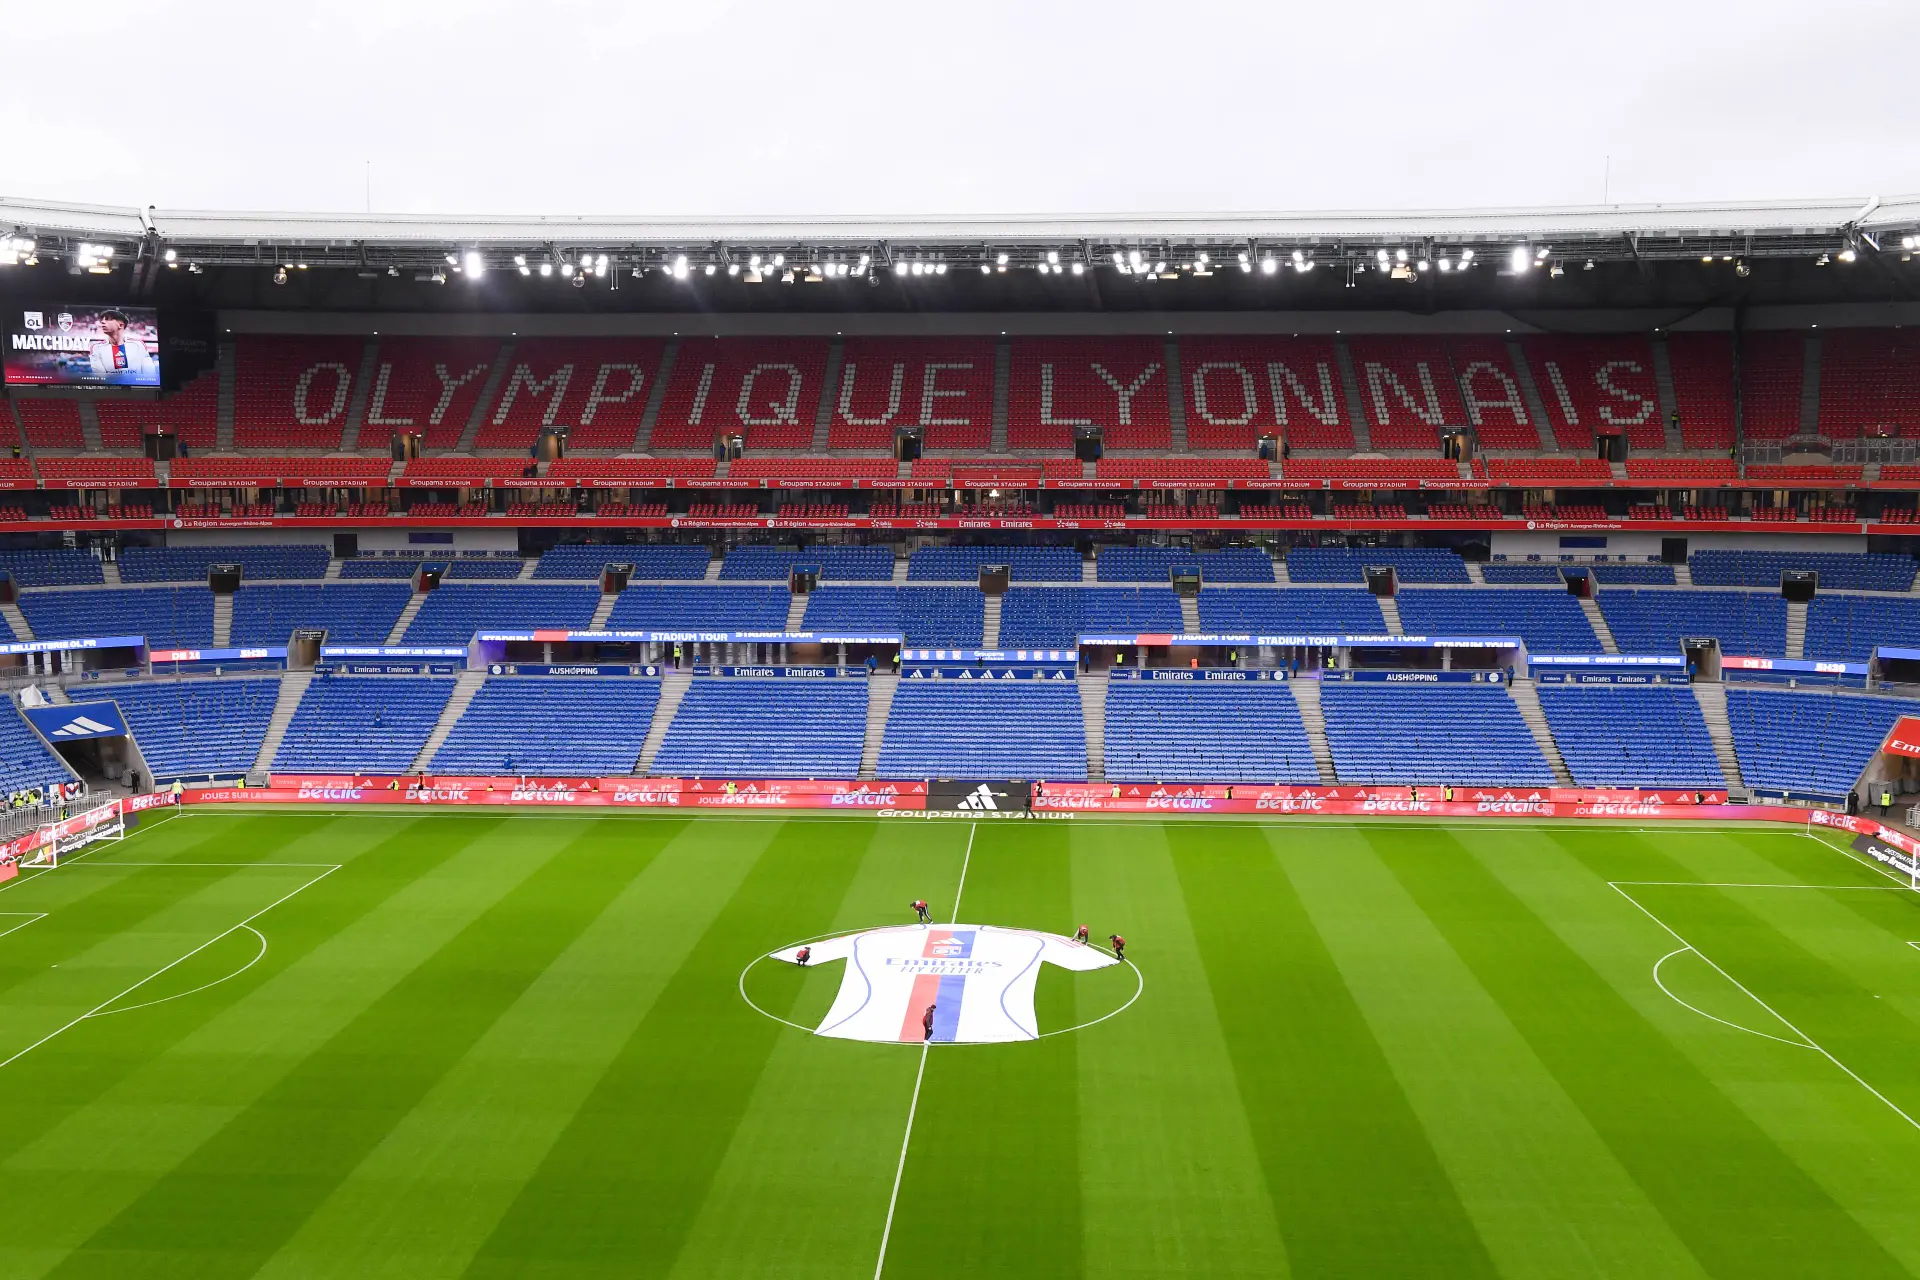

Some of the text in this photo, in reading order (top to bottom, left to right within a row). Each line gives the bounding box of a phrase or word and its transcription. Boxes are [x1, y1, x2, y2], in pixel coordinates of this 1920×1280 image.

[12, 334, 91, 350] MATCHDAY
[294, 362, 1655, 425] OLYMPIQUE LYONNAIS
[66, 480, 106, 488] Groupama
[188, 480, 227, 488] Groupama
[303, 479, 339, 487] Groupama
[410, 479, 443, 487] Groupama
[504, 479, 538, 487] Groupama
[687, 480, 721, 488] Groupama
[779, 480, 813, 488] Groupama
[871, 480, 906, 488] Groupama
[965, 480, 999, 488] Groupama
[1246, 481, 1281, 489] Groupama
[1342, 481, 1378, 489] Groupama
[1424, 481, 1460, 489] Groupama
[194, 520, 218, 528] Région
[688, 520, 710, 528] Région
[959, 520, 1033, 528] Emirates Emirates
[1545, 522, 1569, 530] Région
[650, 632, 728, 641] STADIUM TOUR
[1258, 636, 1338, 645] STADIUM TOUR
[734, 667, 826, 677] Emirates Emirates
[1152, 670, 1246, 680] Emirates Emirates
[1582, 675, 1646, 683] Emirates Emirates
[200, 792, 229, 800] JOUEZ
[132, 793, 176, 811] Betclic
[877, 808, 1074, 819] Groupama STADIUM
[1811, 810, 1857, 830] Betclic
[1867, 846, 1890, 861] Congo
[885, 957, 1003, 967] Emirates
